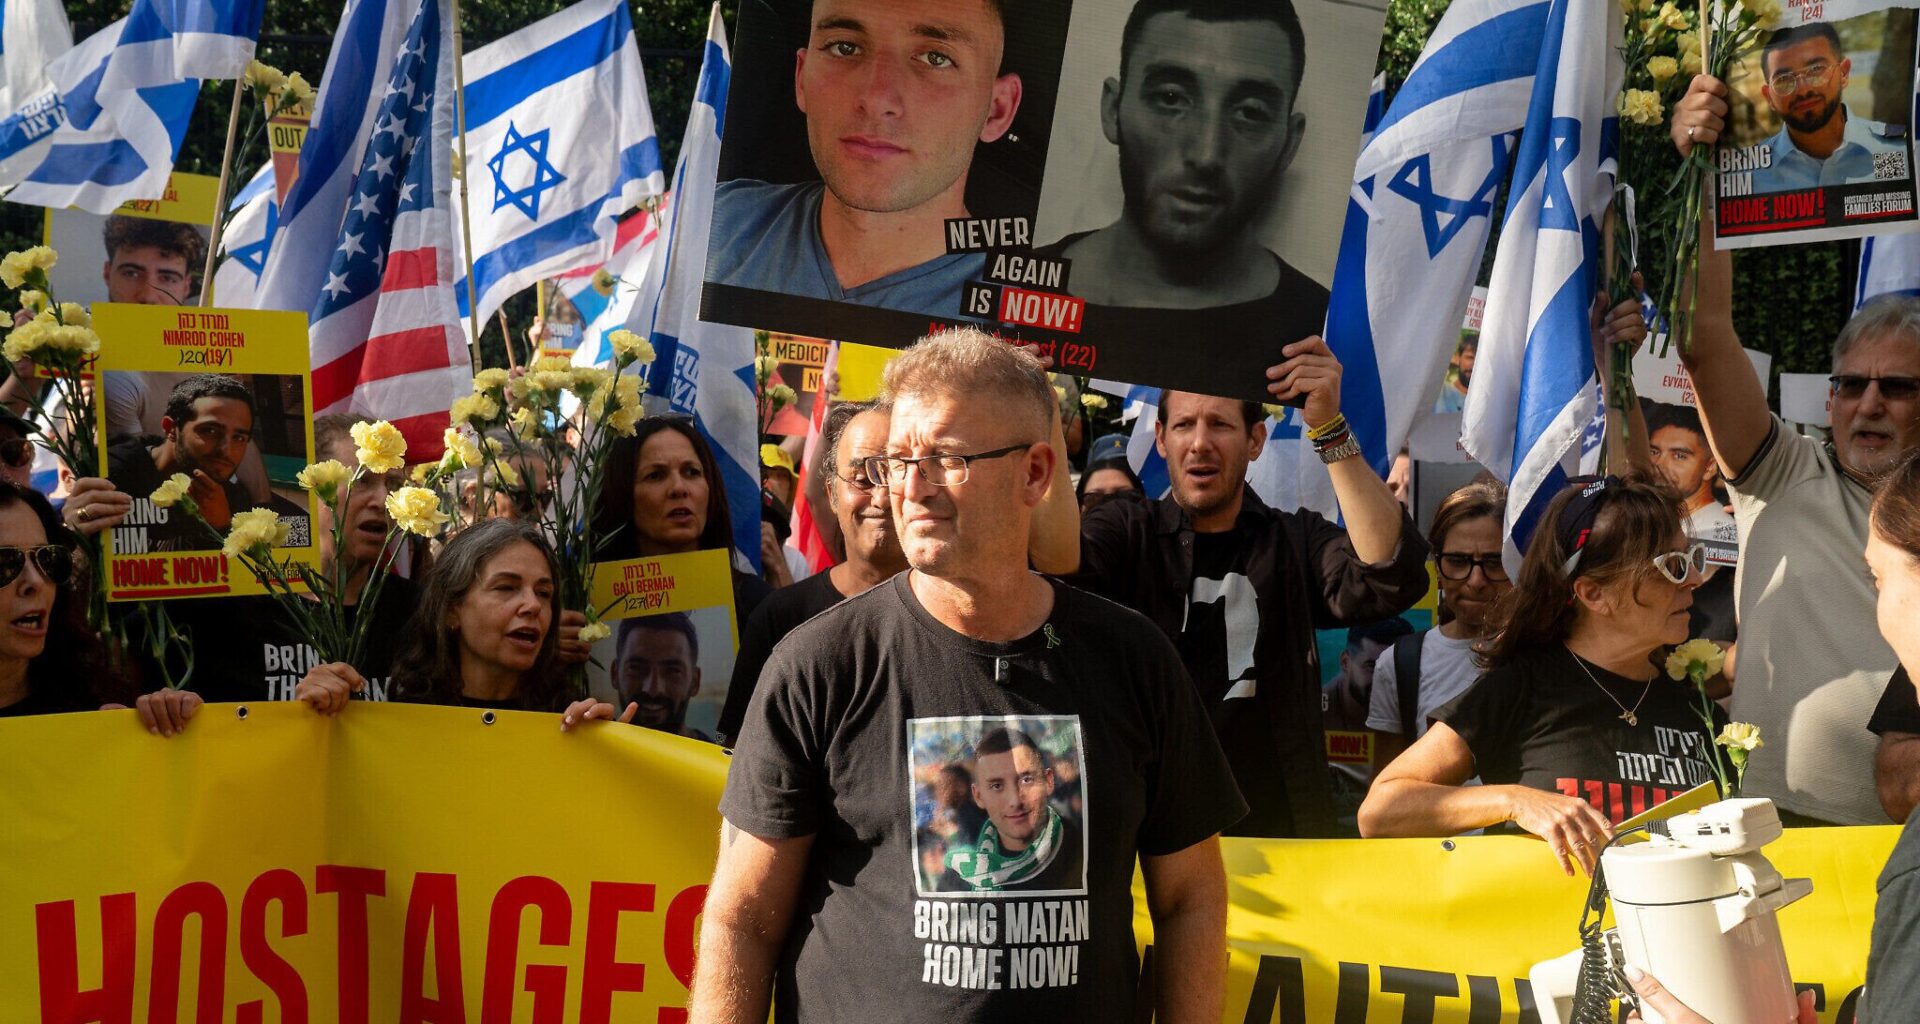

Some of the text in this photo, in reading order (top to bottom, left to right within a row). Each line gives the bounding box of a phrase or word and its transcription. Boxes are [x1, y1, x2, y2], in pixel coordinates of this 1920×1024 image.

[1802, 4, 1823, 22] (24)
[274, 127, 302, 149] OUT
[1720, 144, 1771, 173] BRING
[1720, 172, 1752, 198] HIM
[1844, 191, 1911, 204] HOSTAGES AND MISSING
[1720, 186, 1825, 225] HOME NOW!
[1845, 199, 1912, 216] FAMILIES FORUM
[951, 217, 1030, 249] NEVER
[991, 254, 1062, 288] AGAIN
[177, 312, 229, 330] נמרוד כהן
[969, 287, 1078, 330] IS NOW!
[163, 330, 244, 348] NIMROD COHEN
[1060, 342, 1097, 371] (22)
[1663, 375, 1692, 390] EVYATA
[122, 497, 168, 525] RING
[112, 527, 148, 555] HIM
[112, 552, 230, 587] HOME NOW!
[613, 576, 675, 597] GALI BERMAN
[263, 643, 328, 675] BRIN
[1615, 751, 1687, 785] הביתה
[914, 900, 1089, 945] BRING MATAN
[922, 944, 1003, 990] HOME
[1010, 945, 1079, 989] NOW!
